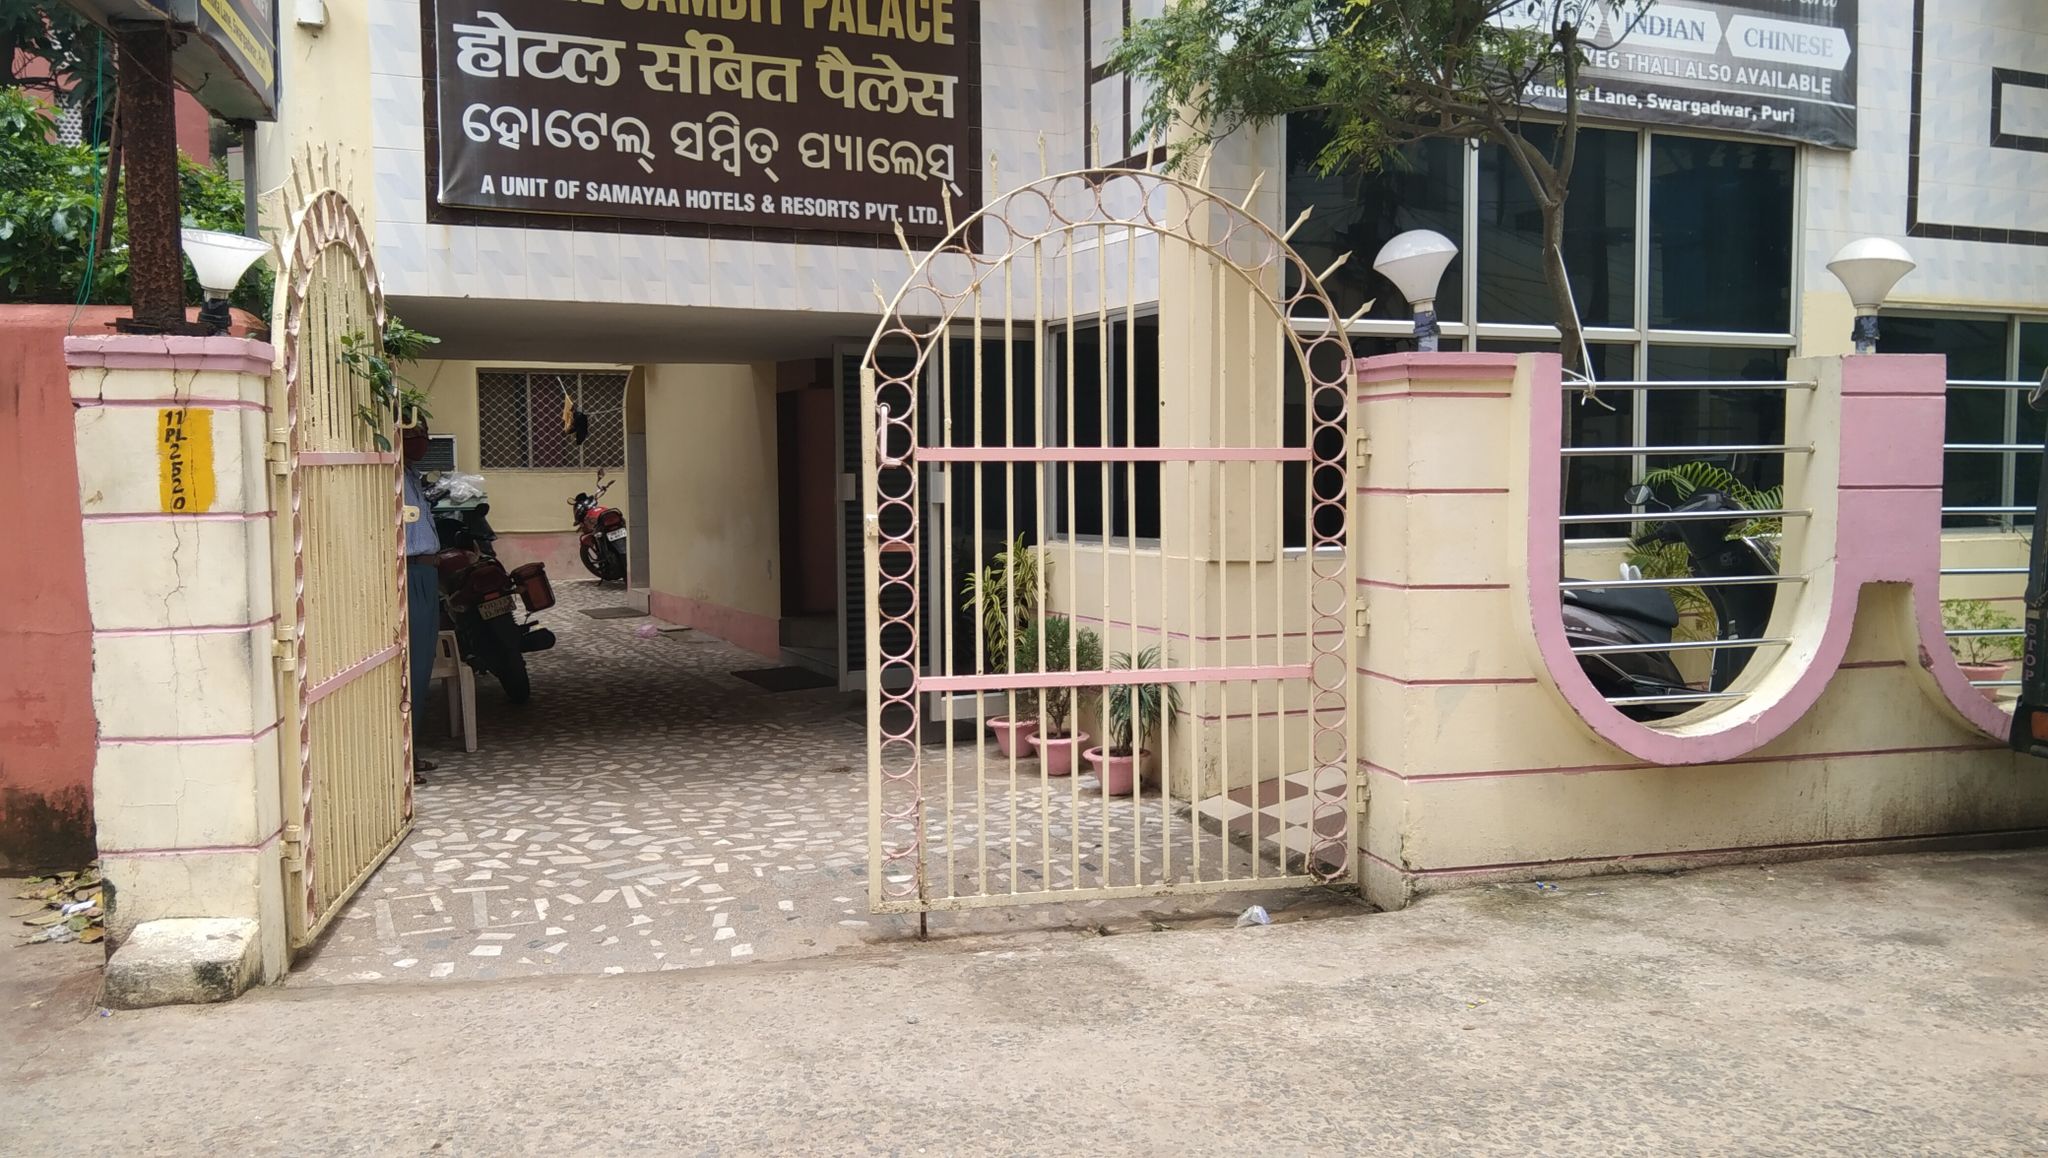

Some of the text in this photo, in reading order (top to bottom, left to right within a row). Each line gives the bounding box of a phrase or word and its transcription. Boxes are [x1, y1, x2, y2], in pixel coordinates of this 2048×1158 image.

[1624, 12, 1833, 58] INDIAN CHINESE
[452, 10, 627, 87] होटल
[816, 46, 959, 118] पैलेस
[1625, 53, 1679, 76] THALI
[1685, 61, 1731, 82] ALSO
[1736, 66, 1832, 95] AVAILABLE
[1595, 87, 1643, 109] Lane,
[1647, 93, 1757, 121] Swargadwar,
[1761, 105, 1795, 123] Puri
[462, 103, 656, 174] ହୋଟେଲ୍
[480, 175, 943, 225] A UNIT OF SAMAYAA HOTELS & RESORTS PVT. LTD.
[165, 428, 188, 443] PL
[2024, 622, 2038, 681] STOP
